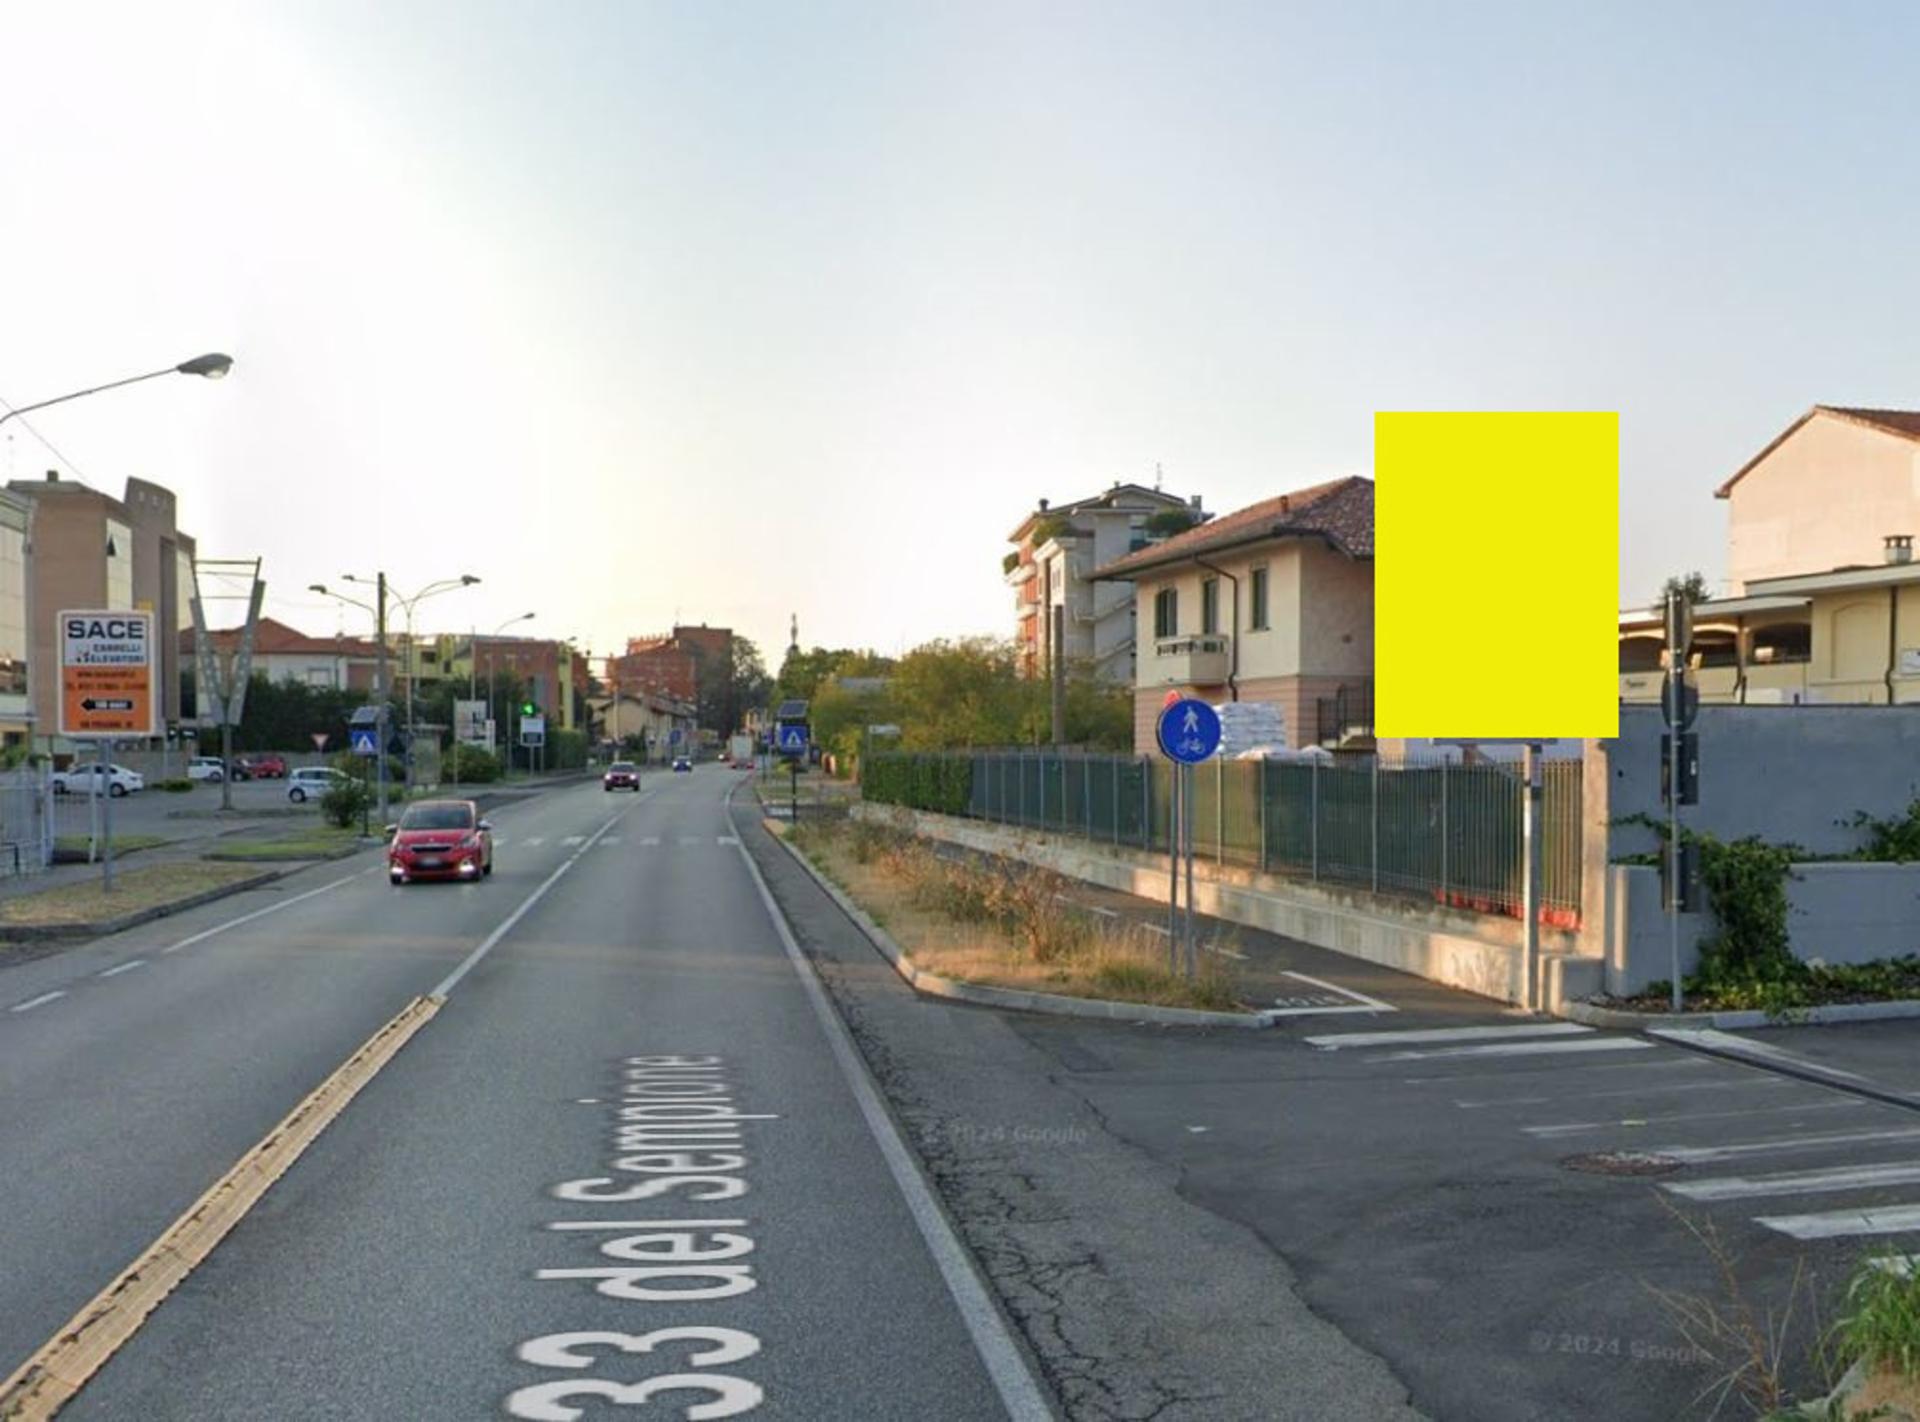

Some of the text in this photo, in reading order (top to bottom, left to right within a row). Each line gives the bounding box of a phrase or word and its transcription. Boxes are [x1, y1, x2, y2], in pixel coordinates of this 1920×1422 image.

[67, 620, 144, 639] SACE
[507, 1055, 779, 1422] 33 del Sempione
